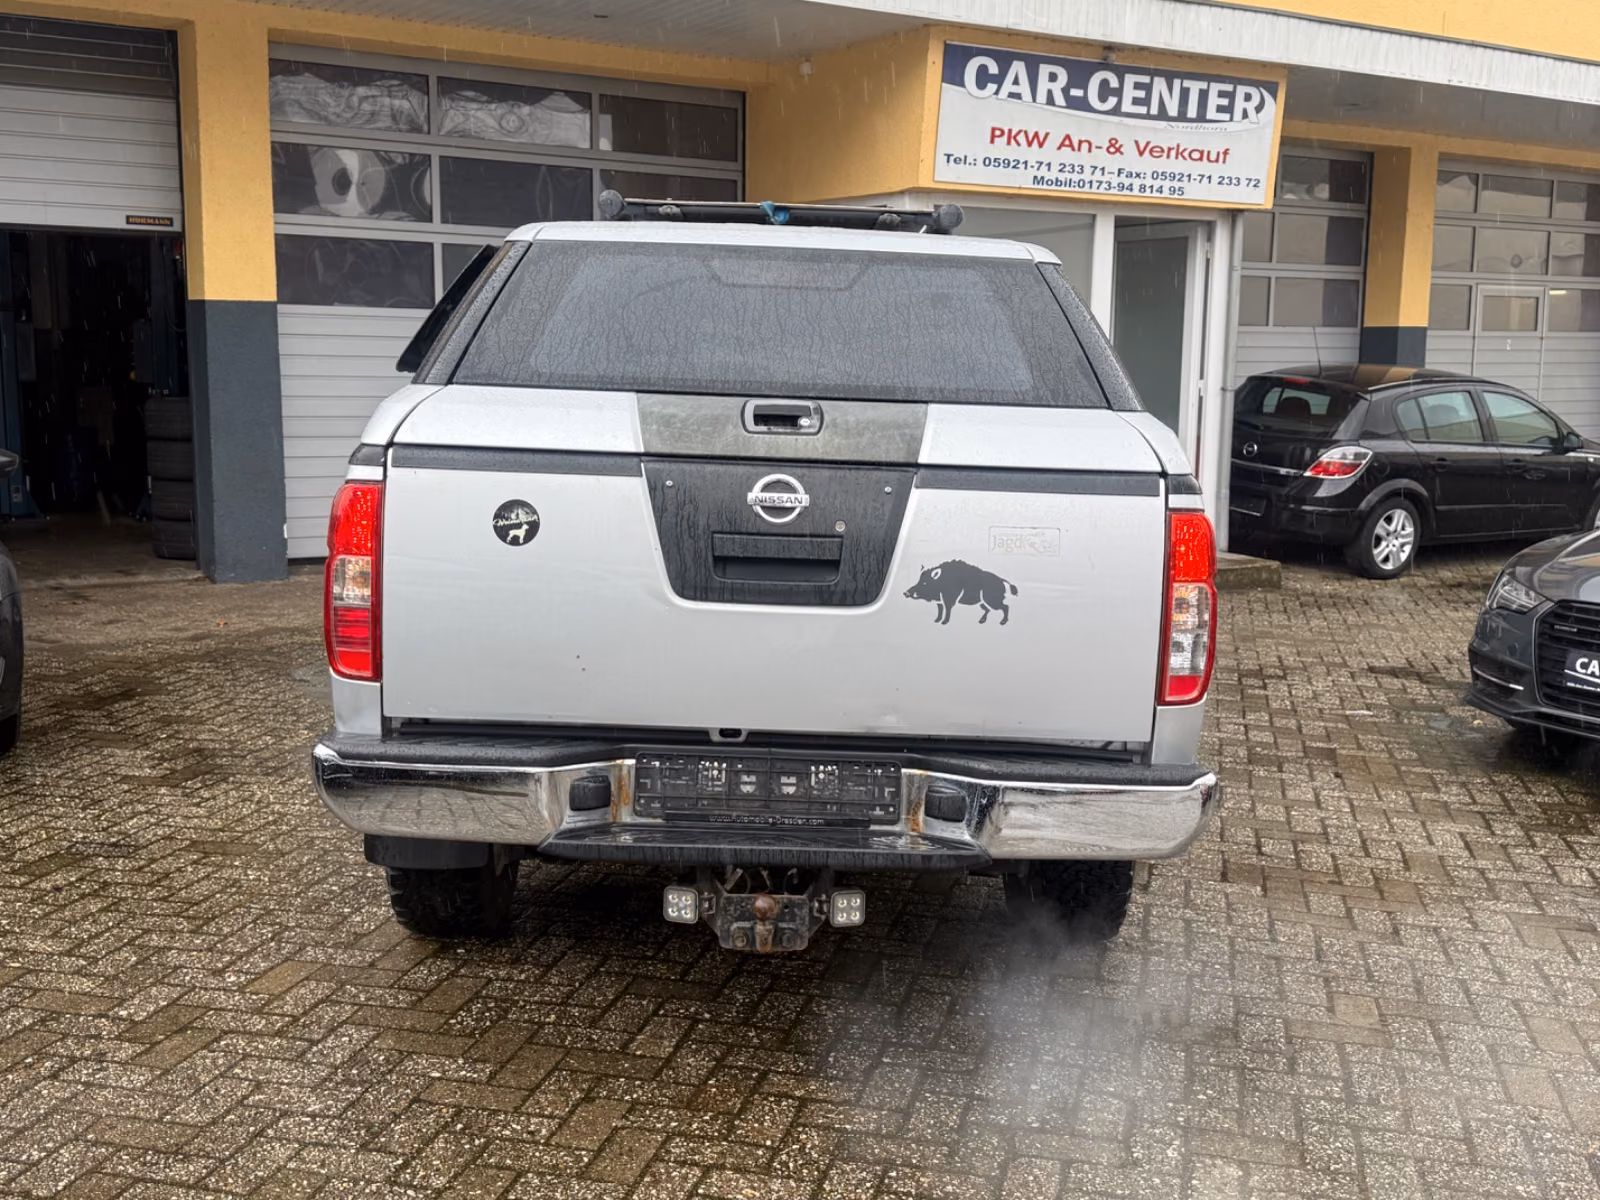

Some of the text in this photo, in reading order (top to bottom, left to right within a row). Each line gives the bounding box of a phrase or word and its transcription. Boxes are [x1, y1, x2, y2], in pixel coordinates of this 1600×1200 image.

[963, 55, 1260, 124] CAR-CENTER
[988, 125, 1050, 149] PKW
[1134, 139, 1230, 165] Verkauf
[943, 152, 978, 167] Tel.:
[982, 156, 1053, 173] 05921-71
[1057, 162, 1085, 175] 233
[1151, 169, 1213, 185] 05921-71
[1217, 175, 1241, 187] 233
[1245, 177, 1261, 189] 72
[1138, 183, 1164, 195] 814
[1168, 185, 1185, 197] 95
[754, 495, 804, 505] NISSAN
